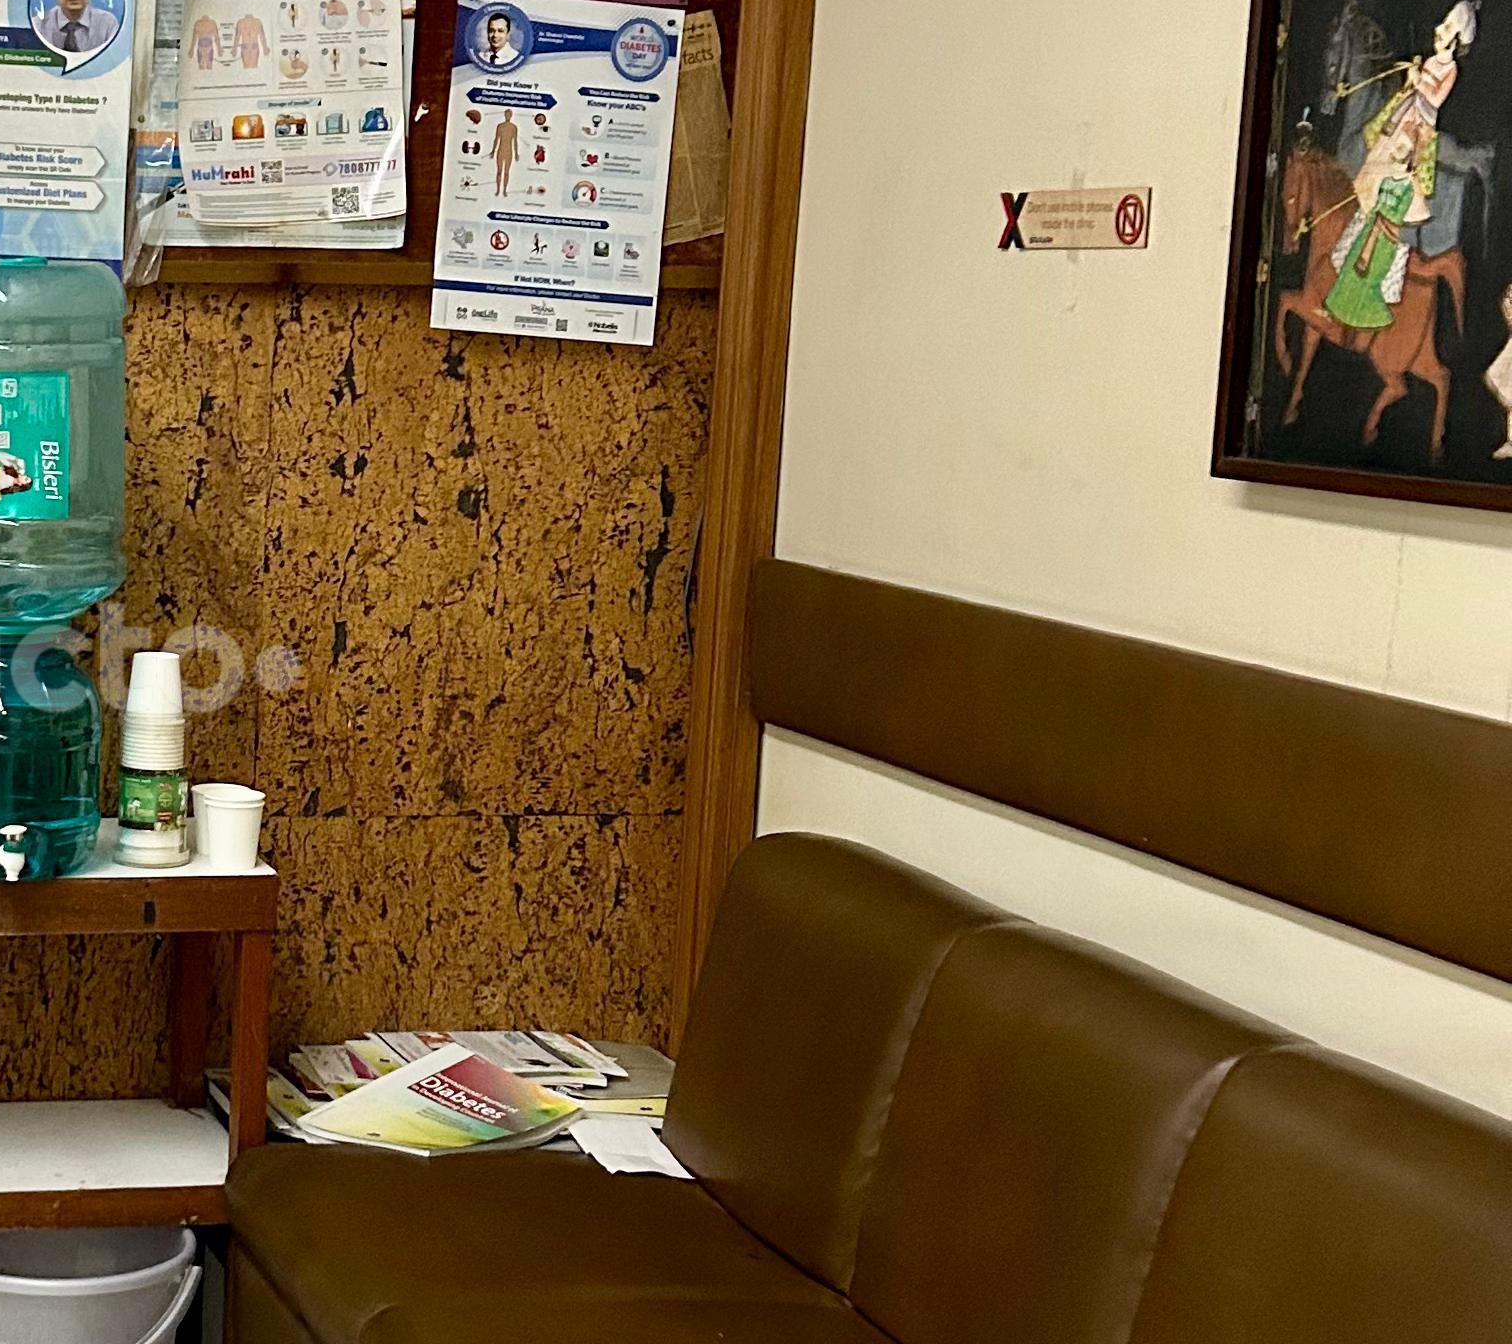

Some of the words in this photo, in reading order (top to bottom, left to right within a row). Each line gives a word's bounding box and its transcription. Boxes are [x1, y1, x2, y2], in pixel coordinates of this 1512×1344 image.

[620, 41, 662, 53] DIABETES
[5, 54, 35, 62] Diabetes
[35, 55, 52, 63] Care
[513, 81, 532, 89] Know
[34, 94, 53, 105] Type
[63, 95, 99, 106] Diabetes
[608, 102, 625, 110] your
[36, 154, 55, 163] Risk
[57, 155, 83, 165] Score
[191, 164, 255, 181] HuMrahi
[43, 188, 60, 197] Diet
[63, 189, 87, 198] Plans
[39, 440, 63, 500] Bisleri
[419, 1076, 507, 1119] Diabetes
